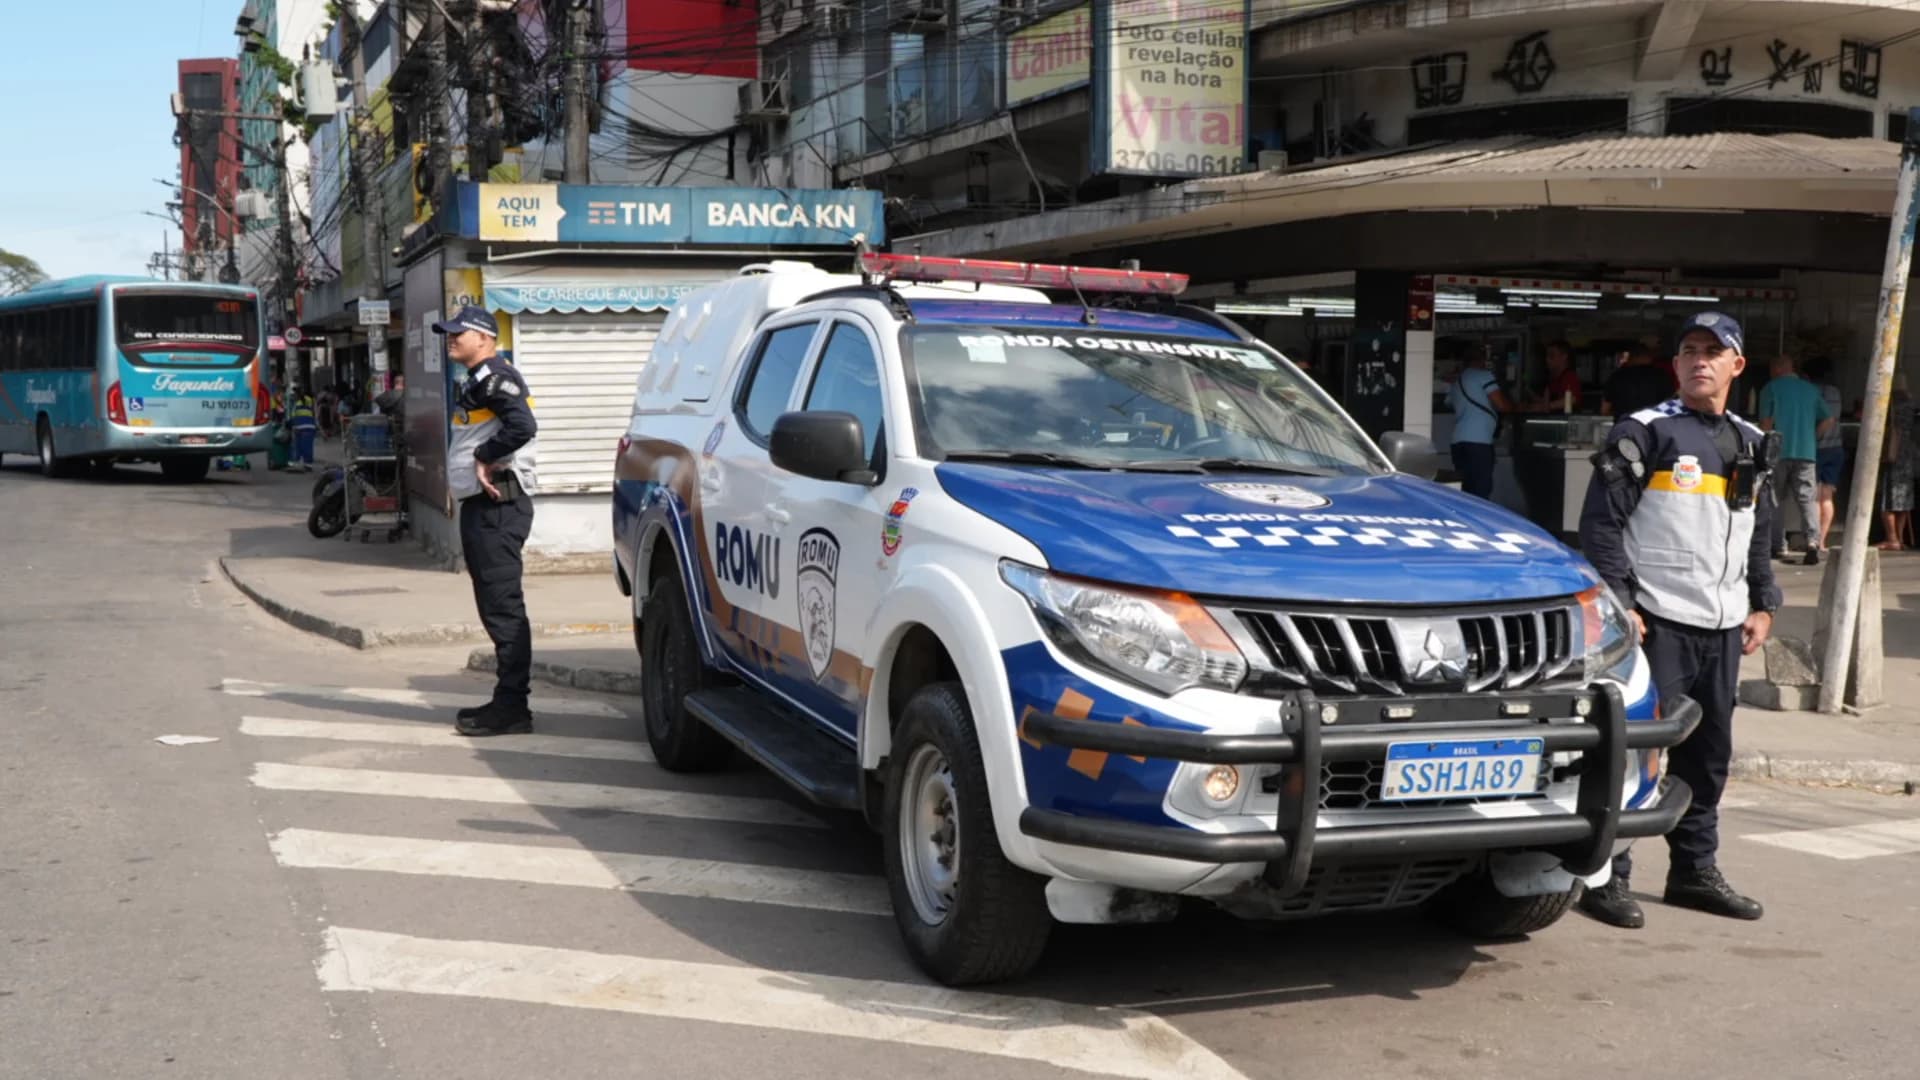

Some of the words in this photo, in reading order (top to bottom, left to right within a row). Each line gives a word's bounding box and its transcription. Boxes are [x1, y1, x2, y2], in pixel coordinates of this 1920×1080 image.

[1117, 20, 1164, 41] Foto
[1128, 46, 1234, 70] revelação
[1140, 69, 1166, 83] na
[1174, 68, 1222, 88] hora
[1119, 94, 1244, 145] Vital
[497, 197, 540, 213] AQUI
[620, 202, 671, 226] TIM
[708, 202, 811, 228] BANCA
[816, 204, 856, 229] KN
[502, 214, 537, 228] TEM
[518, 287, 614, 302] RECARREGUE
[620, 287, 651, 302] AQUI
[657, 287, 668, 299] O
[957, 335, 1073, 348] RONDA
[1076, 337, 1241, 362] OSTENSIVA
[152, 374, 234, 395] Fagundes
[202, 401, 216, 409] RJ
[1182, 513, 1298, 523] RONDA
[1300, 514, 1468, 529] OSTENSIVA
[716, 521, 781, 600] ROMU
[801, 538, 836, 573] ROMU
[1453, 747, 1478, 755] BRASIL
[1399, 759, 1524, 793] SSH1A89
